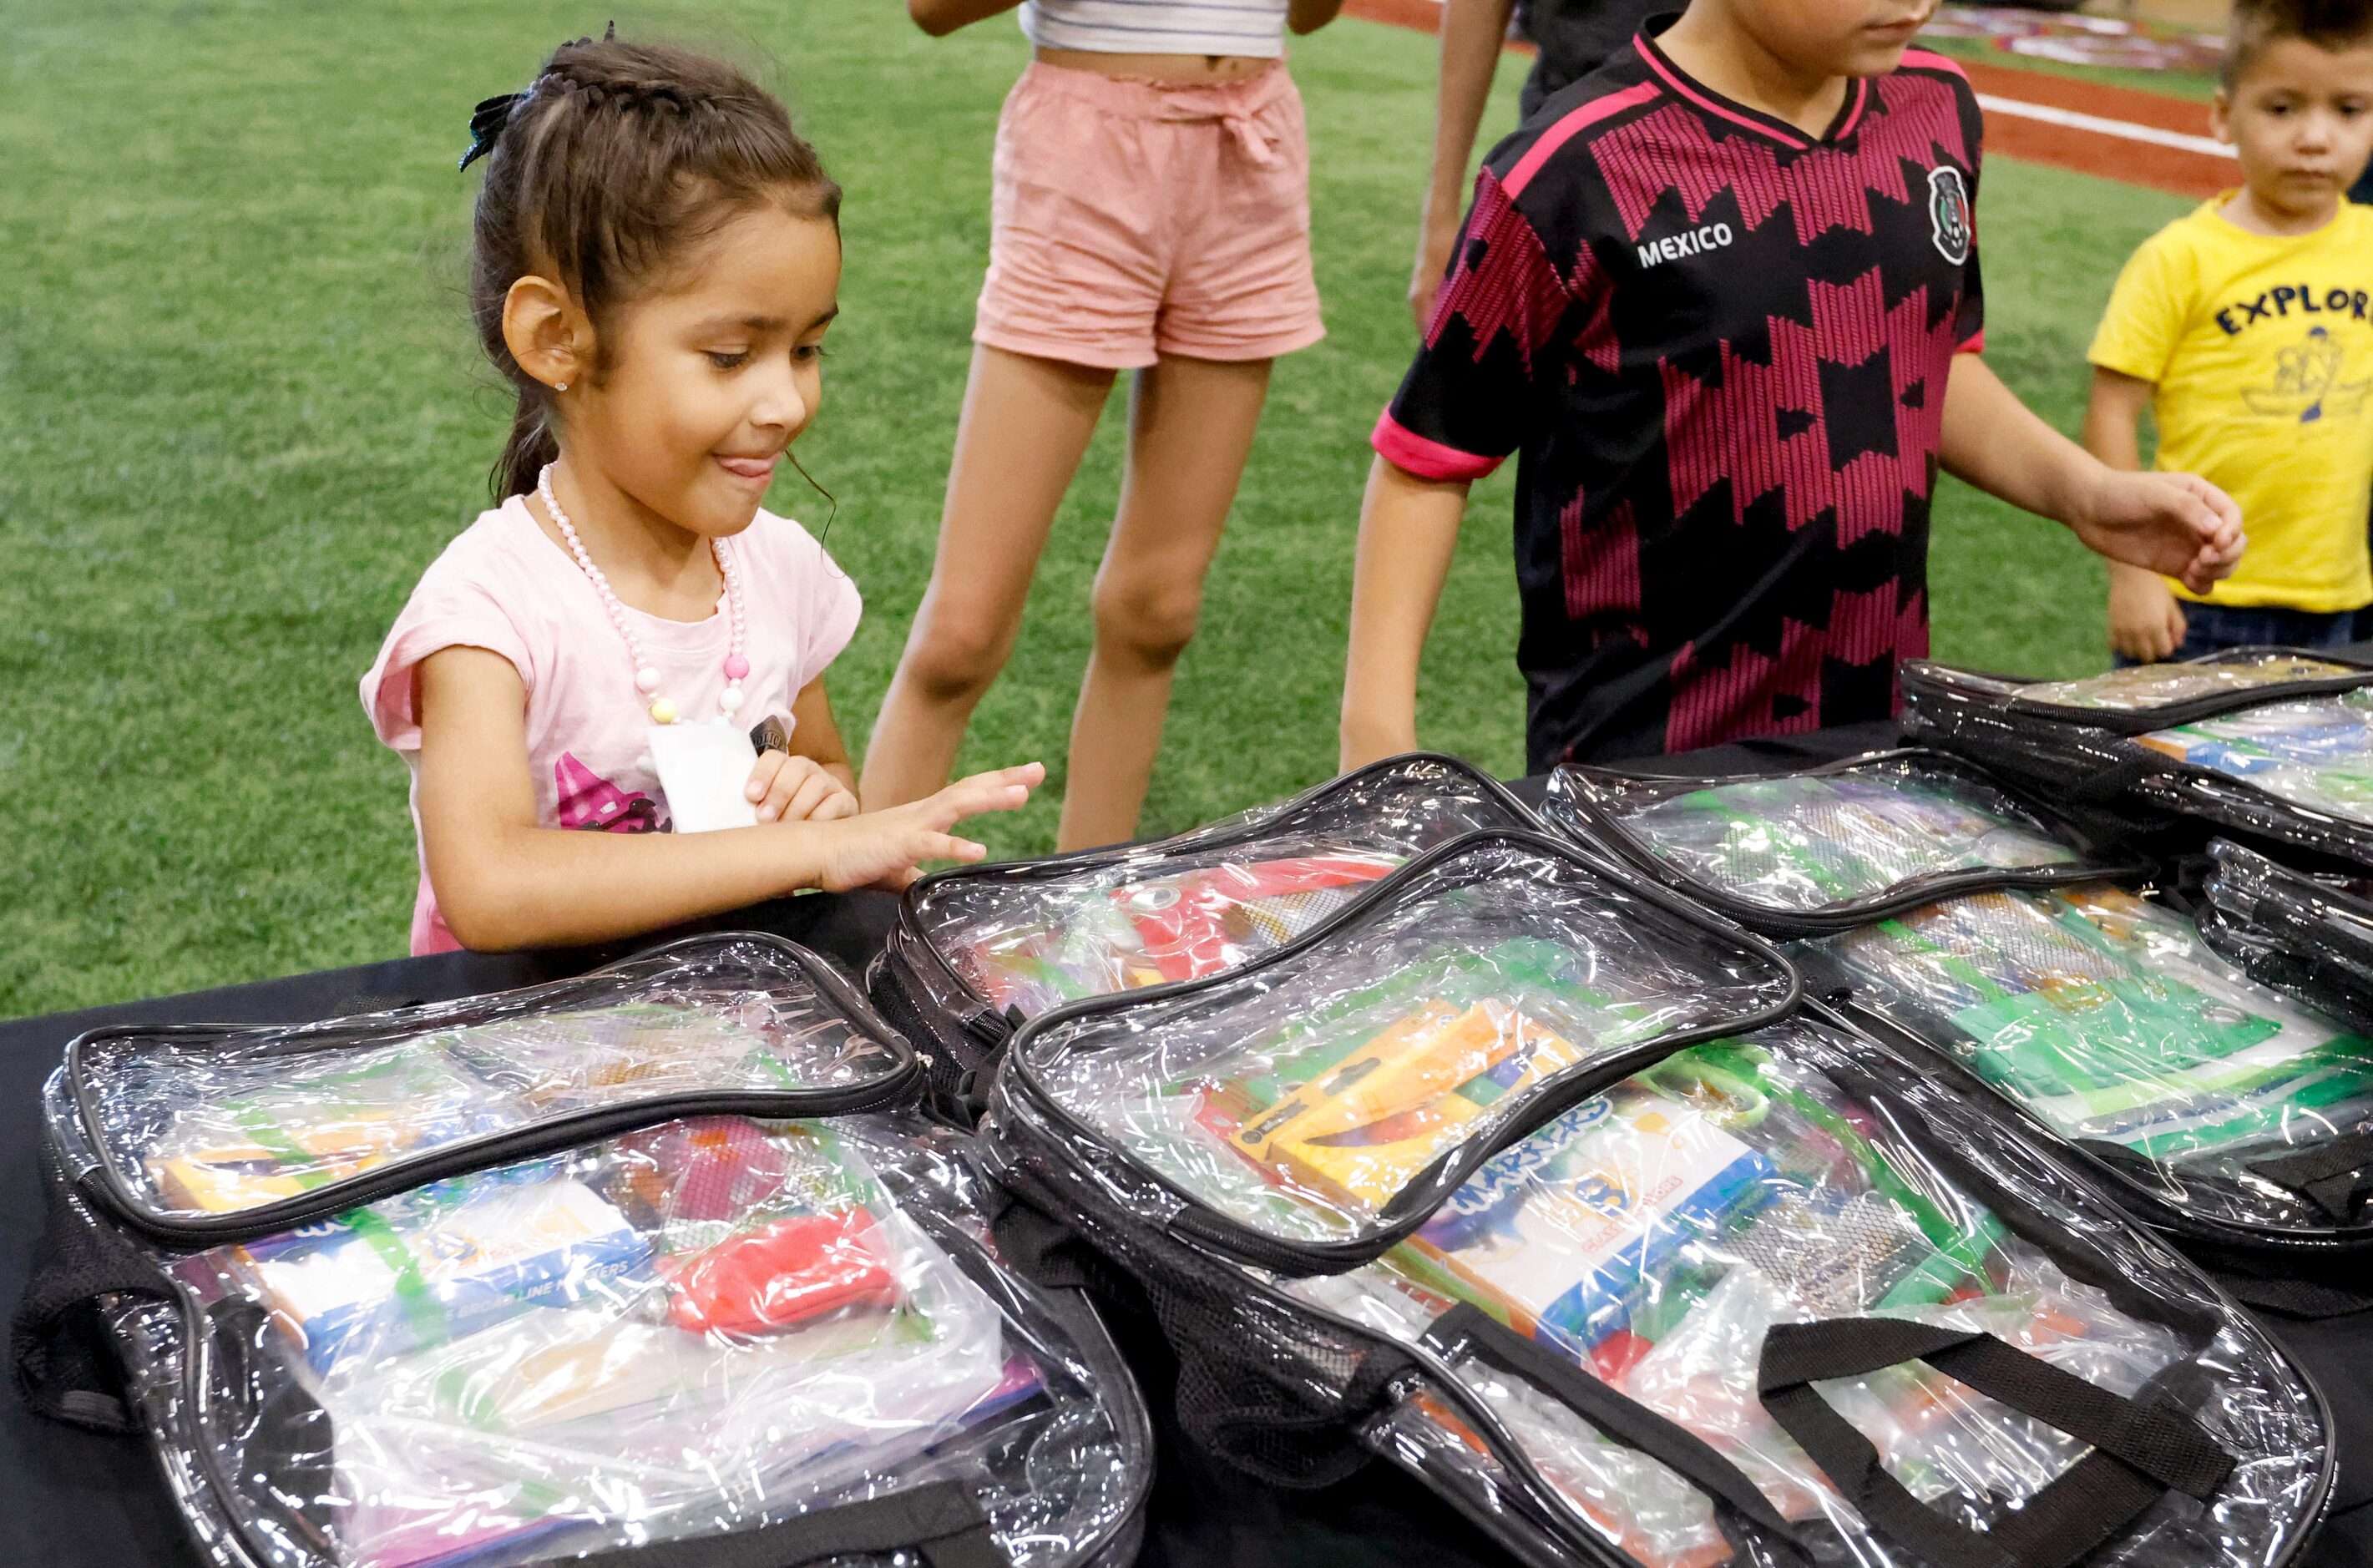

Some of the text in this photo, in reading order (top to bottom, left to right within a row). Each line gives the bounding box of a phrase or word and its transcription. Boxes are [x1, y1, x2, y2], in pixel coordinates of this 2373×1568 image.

[1637, 223, 1733, 268] MEXICO
[2216, 286, 2373, 336] EXPLOR
[554, 1258, 630, 1292] MKERS
